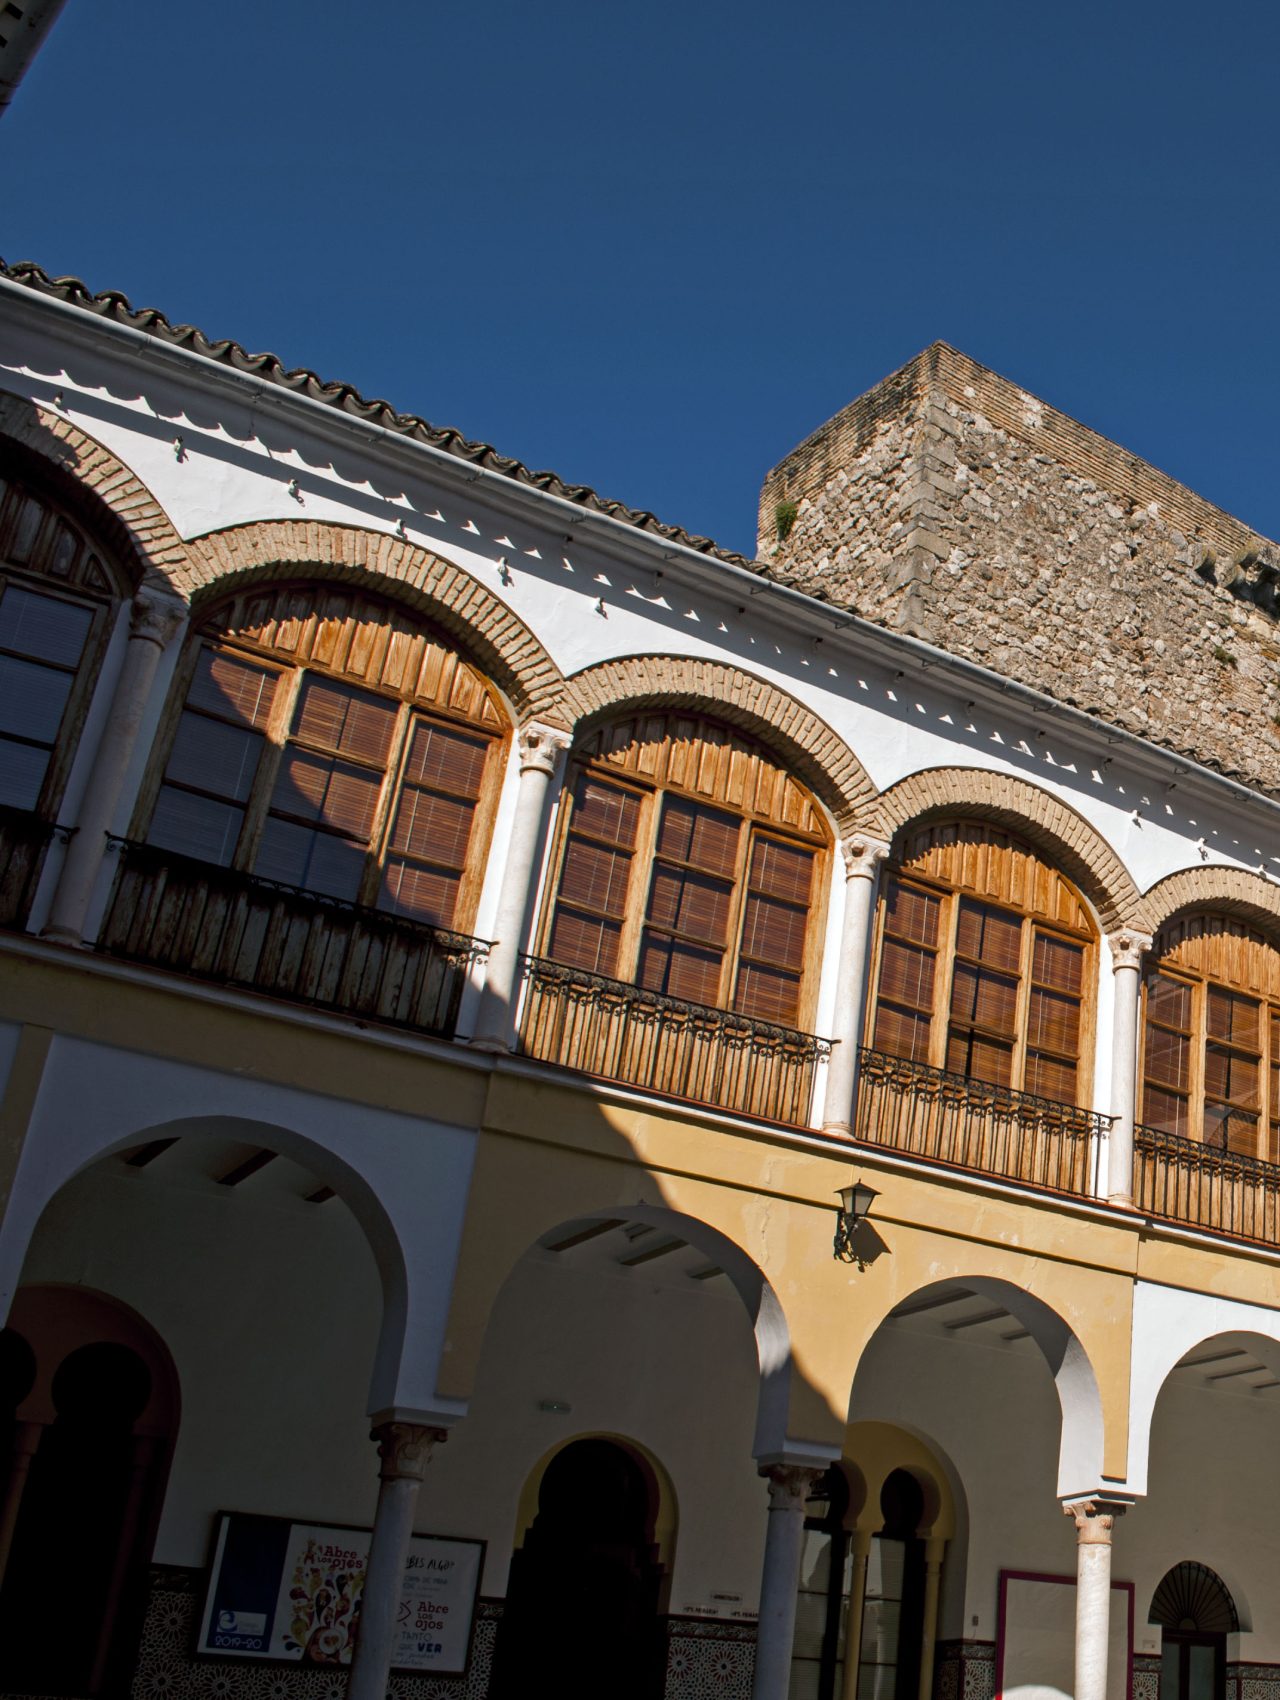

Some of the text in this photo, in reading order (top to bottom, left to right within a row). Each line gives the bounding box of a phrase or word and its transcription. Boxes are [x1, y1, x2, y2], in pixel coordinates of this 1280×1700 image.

[324, 1546, 357, 1559] Abre
[417, 1601, 449, 1614] Abre
[215, 1635, 263, 1649] 2019-20
[402, 1631, 432, 1641] TANTO
[418, 1642, 442, 1653] VER
